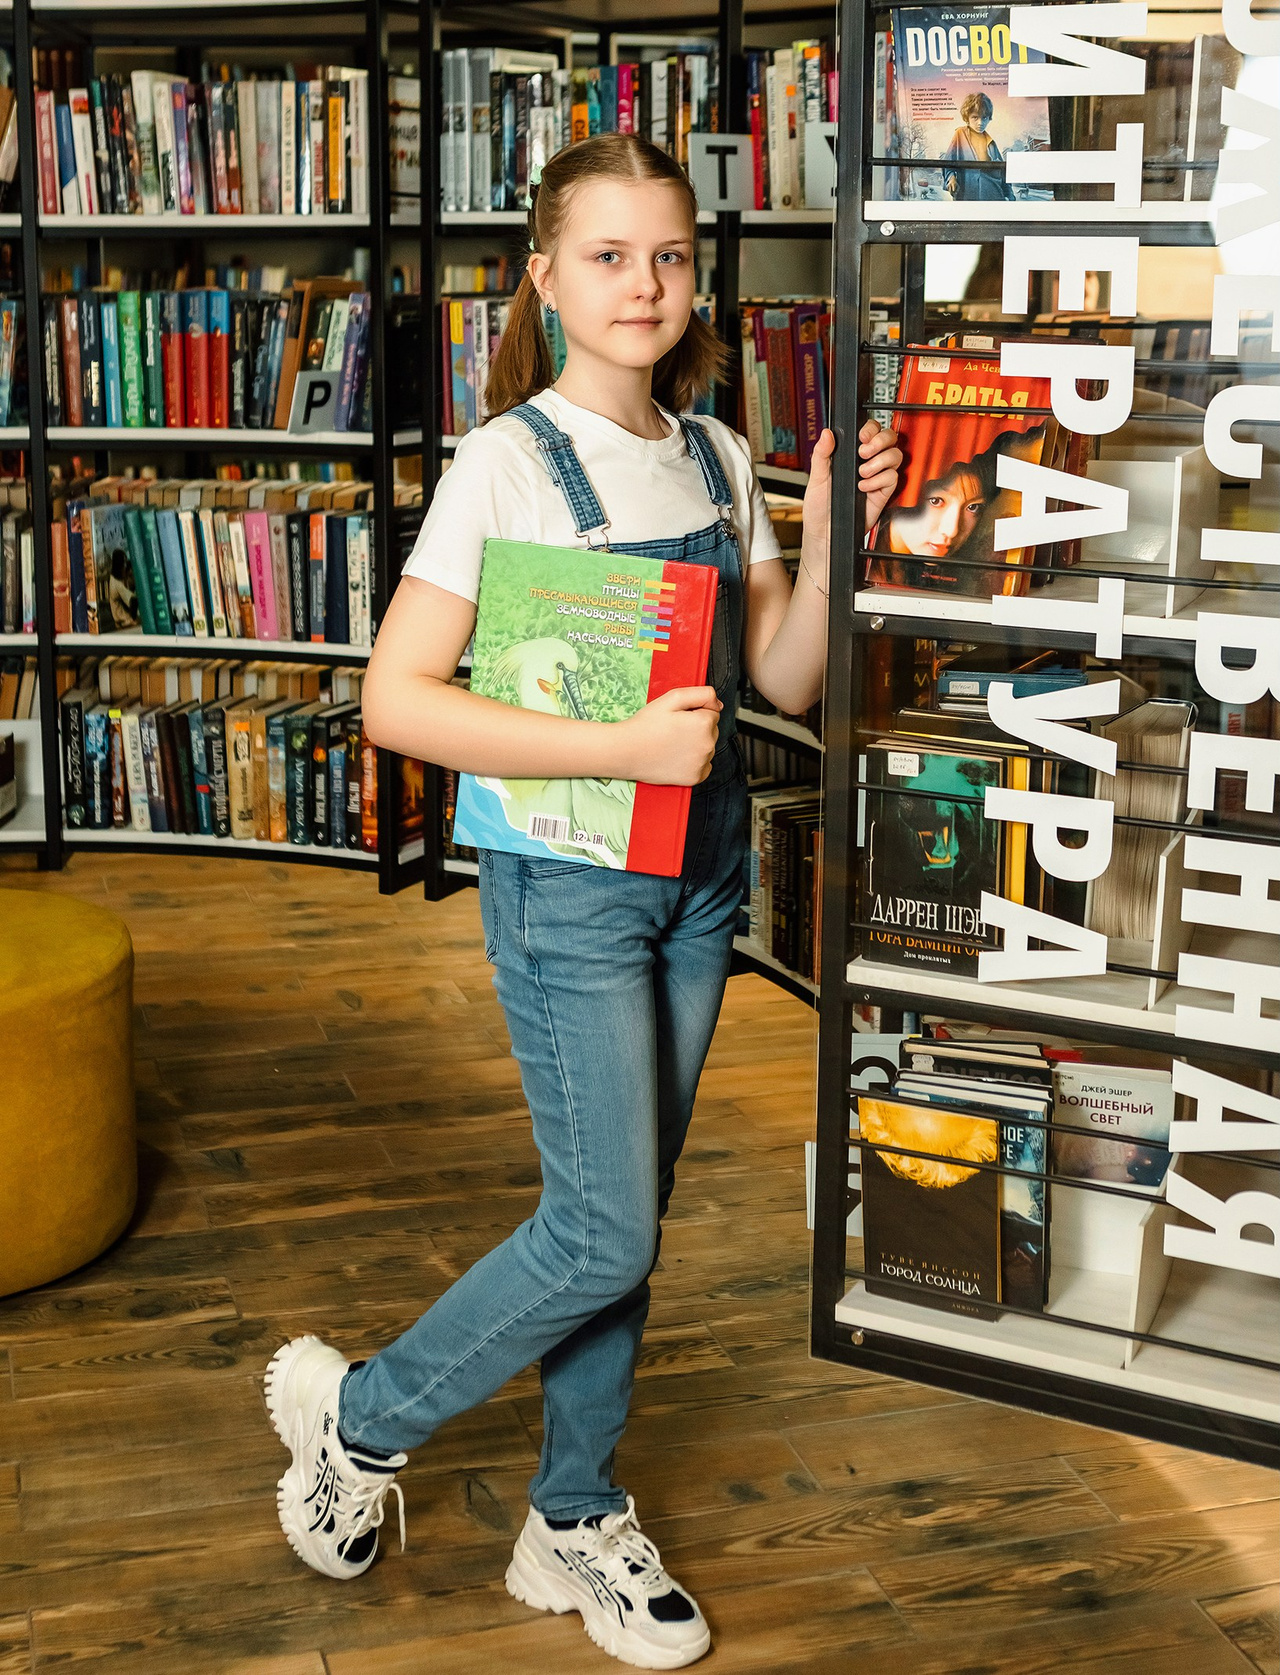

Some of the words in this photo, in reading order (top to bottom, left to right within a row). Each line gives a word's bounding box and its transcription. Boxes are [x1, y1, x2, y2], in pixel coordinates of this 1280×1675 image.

[956, 12, 989, 20] ХОРНУНГ
[706, 145, 738, 200] Т
[963, 361, 978, 373] Да
[302, 380, 332, 426] Р
[606, 573, 641, 587] ЗВЕРИ
[528, 587, 638, 610] ПРЕСМЫКАЮЩИЕСЯ
[601, 585, 640, 600] ПТИЦЫ
[556, 603, 636, 623] ЗЕМНОВОДНЫЕ
[604, 622, 636, 635] РЫБЫ
[567, 630, 633, 649] НАСЕКОМЫЕ
[870, 893, 940, 931] ДАРРЕН
[944, 903, 987, 938] ШЭН
[903, 949, 917, 959] Дом
[917, 952, 952, 964] проклятых
[1080, 1083, 1106, 1095] ДЖЕЙ
[1108, 1086, 1133, 1098] ЭШЕР
[1058, 1094, 1154, 1117] ВОЛШЕБНЫЙ
[1089, 1111, 1122, 1126] СВЕТ
[879, 1261, 923, 1286] ГОРОД
[925, 1272, 982, 1297] СОЛНЦА
